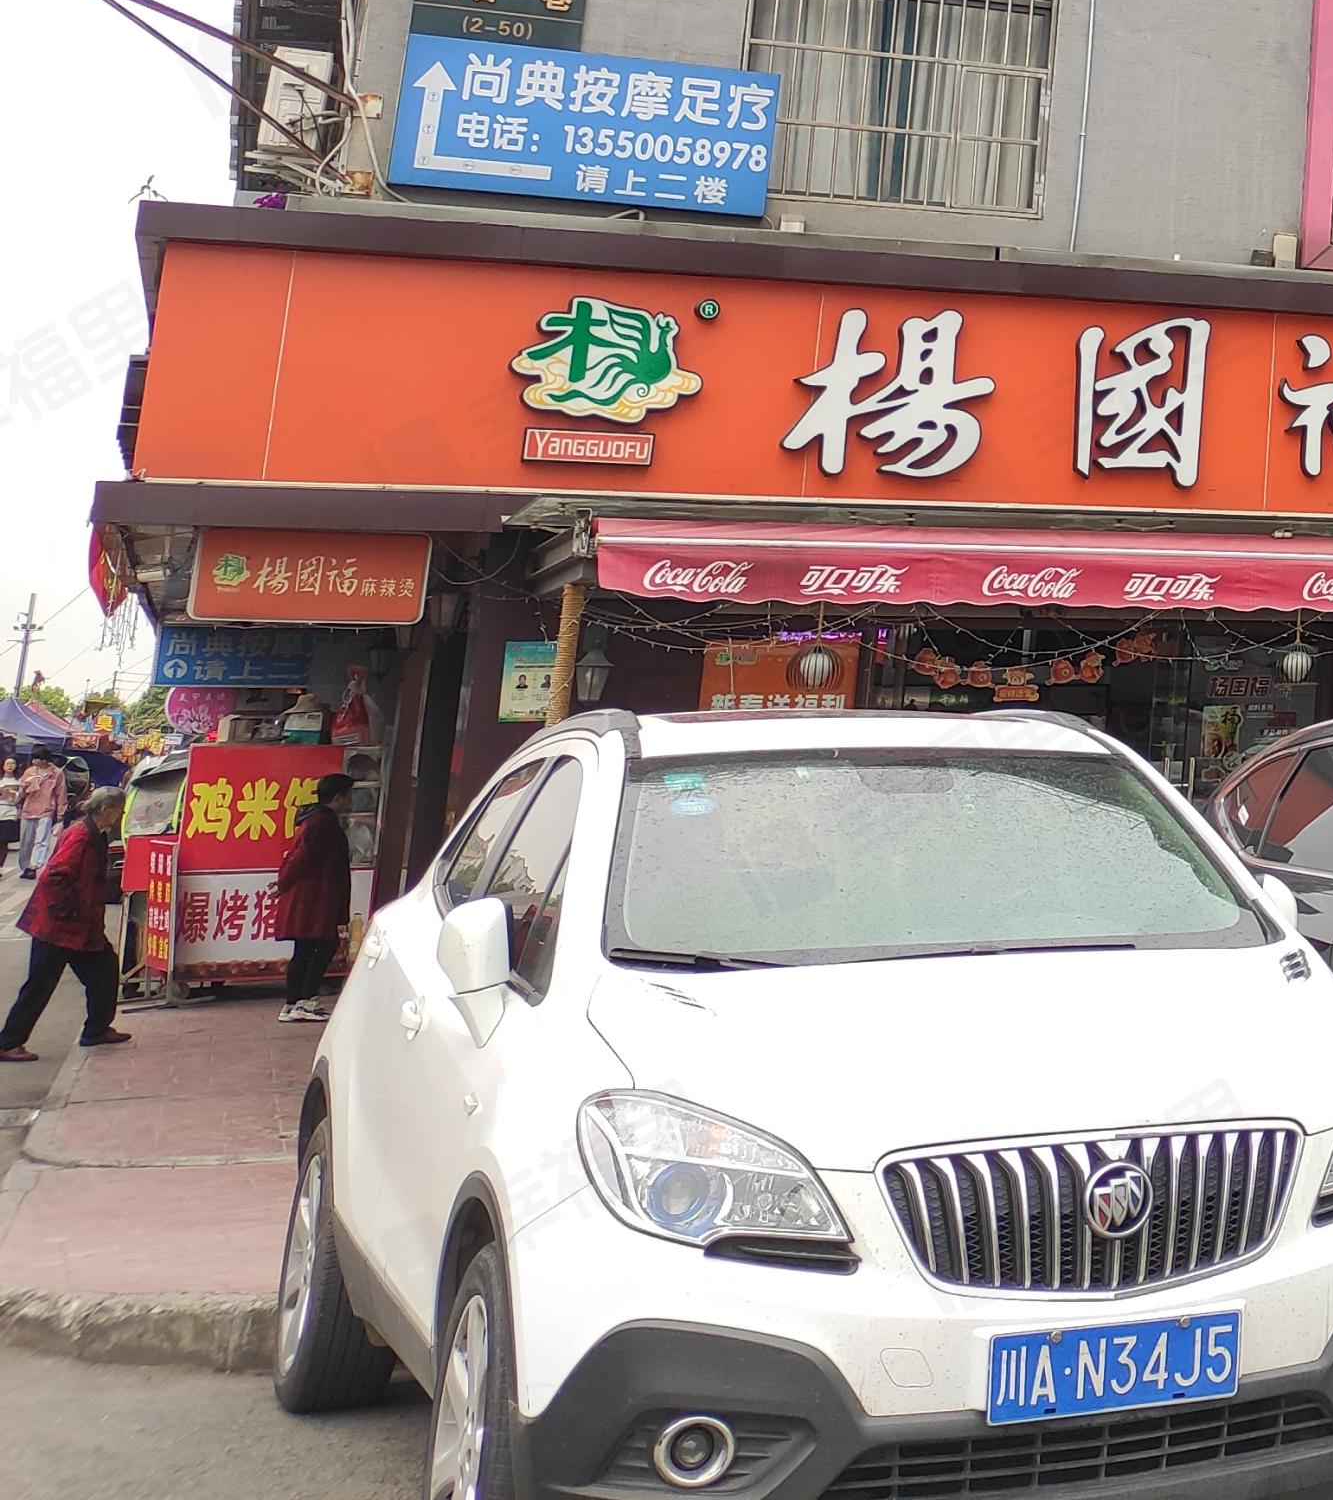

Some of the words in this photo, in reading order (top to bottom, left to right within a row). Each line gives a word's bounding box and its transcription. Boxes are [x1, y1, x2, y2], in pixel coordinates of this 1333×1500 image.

[462, 15, 534, 40] (2-50)
[461, 53, 775, 132] 尚典按摩足疗
[575, 163, 728, 206] 请上二楼
[360, 578, 416, 598] 麻辣烫
[799, 564, 911, 597] 可口可乐
[1123, 572, 1221, 602] 可口可乐
[193, 659, 308, 681] 请上二
